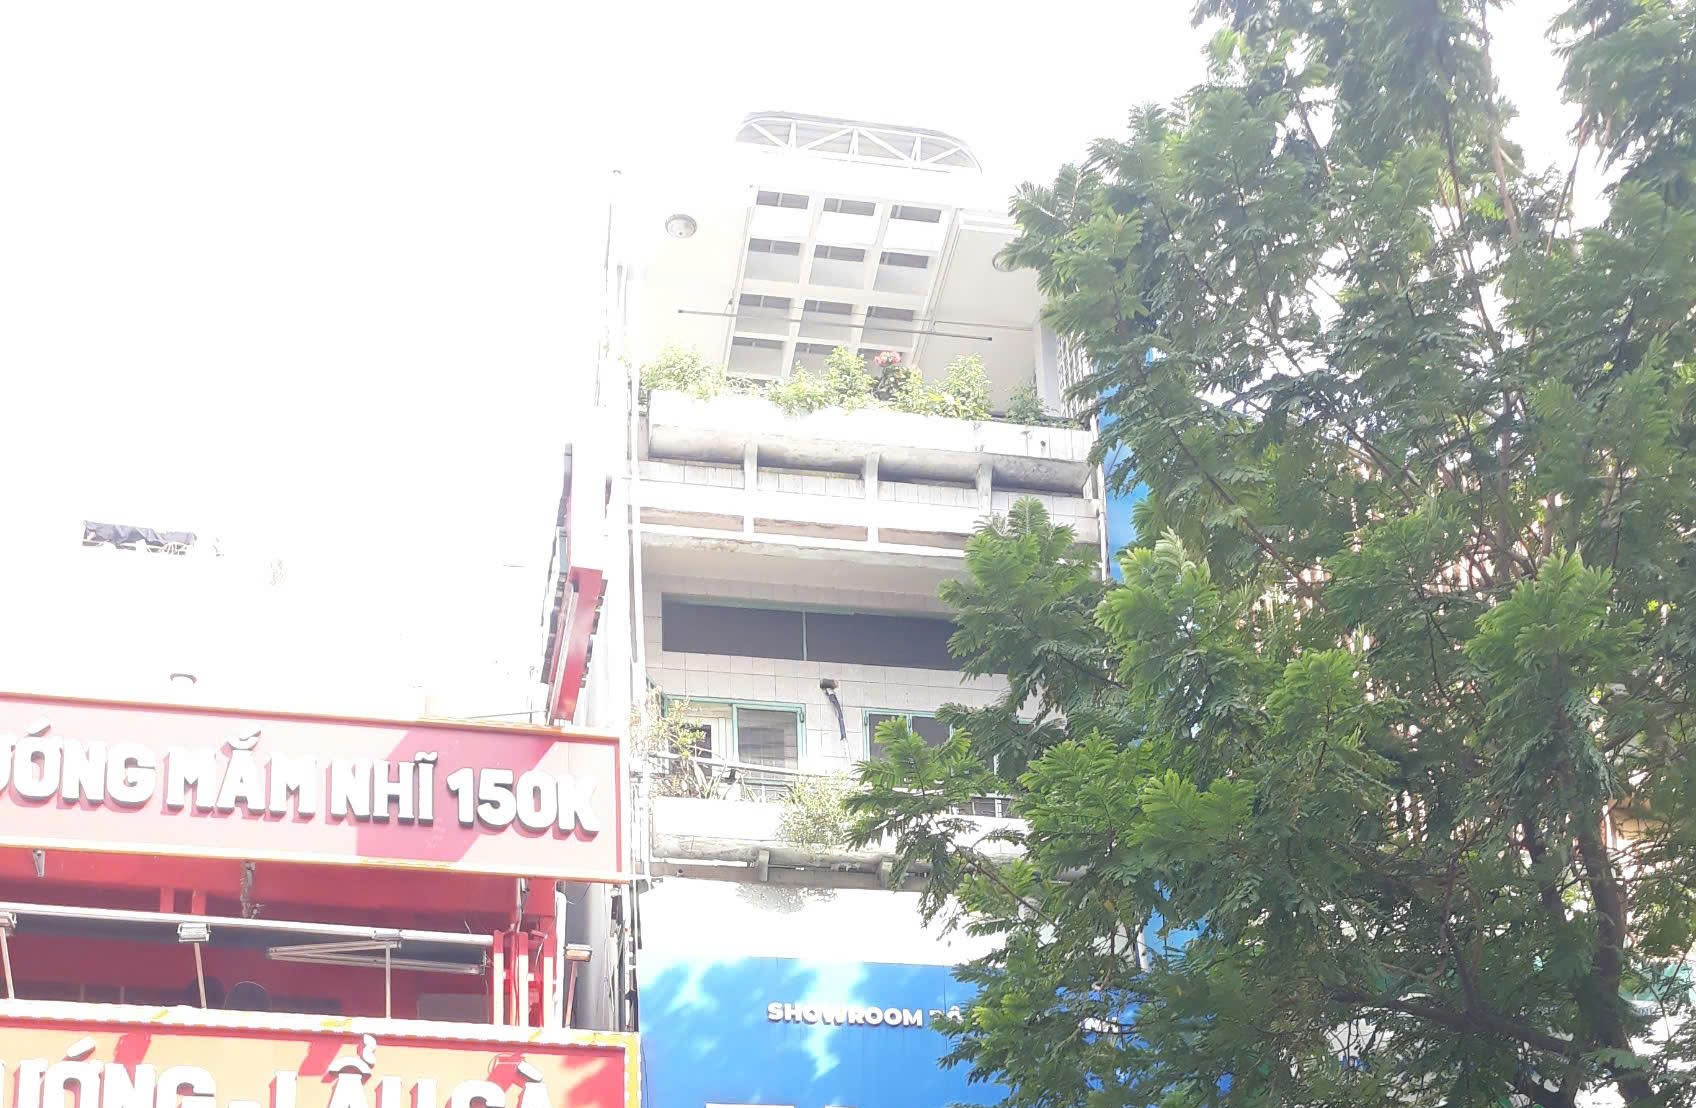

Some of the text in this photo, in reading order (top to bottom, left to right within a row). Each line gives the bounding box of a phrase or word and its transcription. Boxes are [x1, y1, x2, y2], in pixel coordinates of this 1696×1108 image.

[328, 751, 438, 824] NHĨ
[446, 766, 600, 835] 150K
[767, 1001, 923, 1028] SHOWROOM
